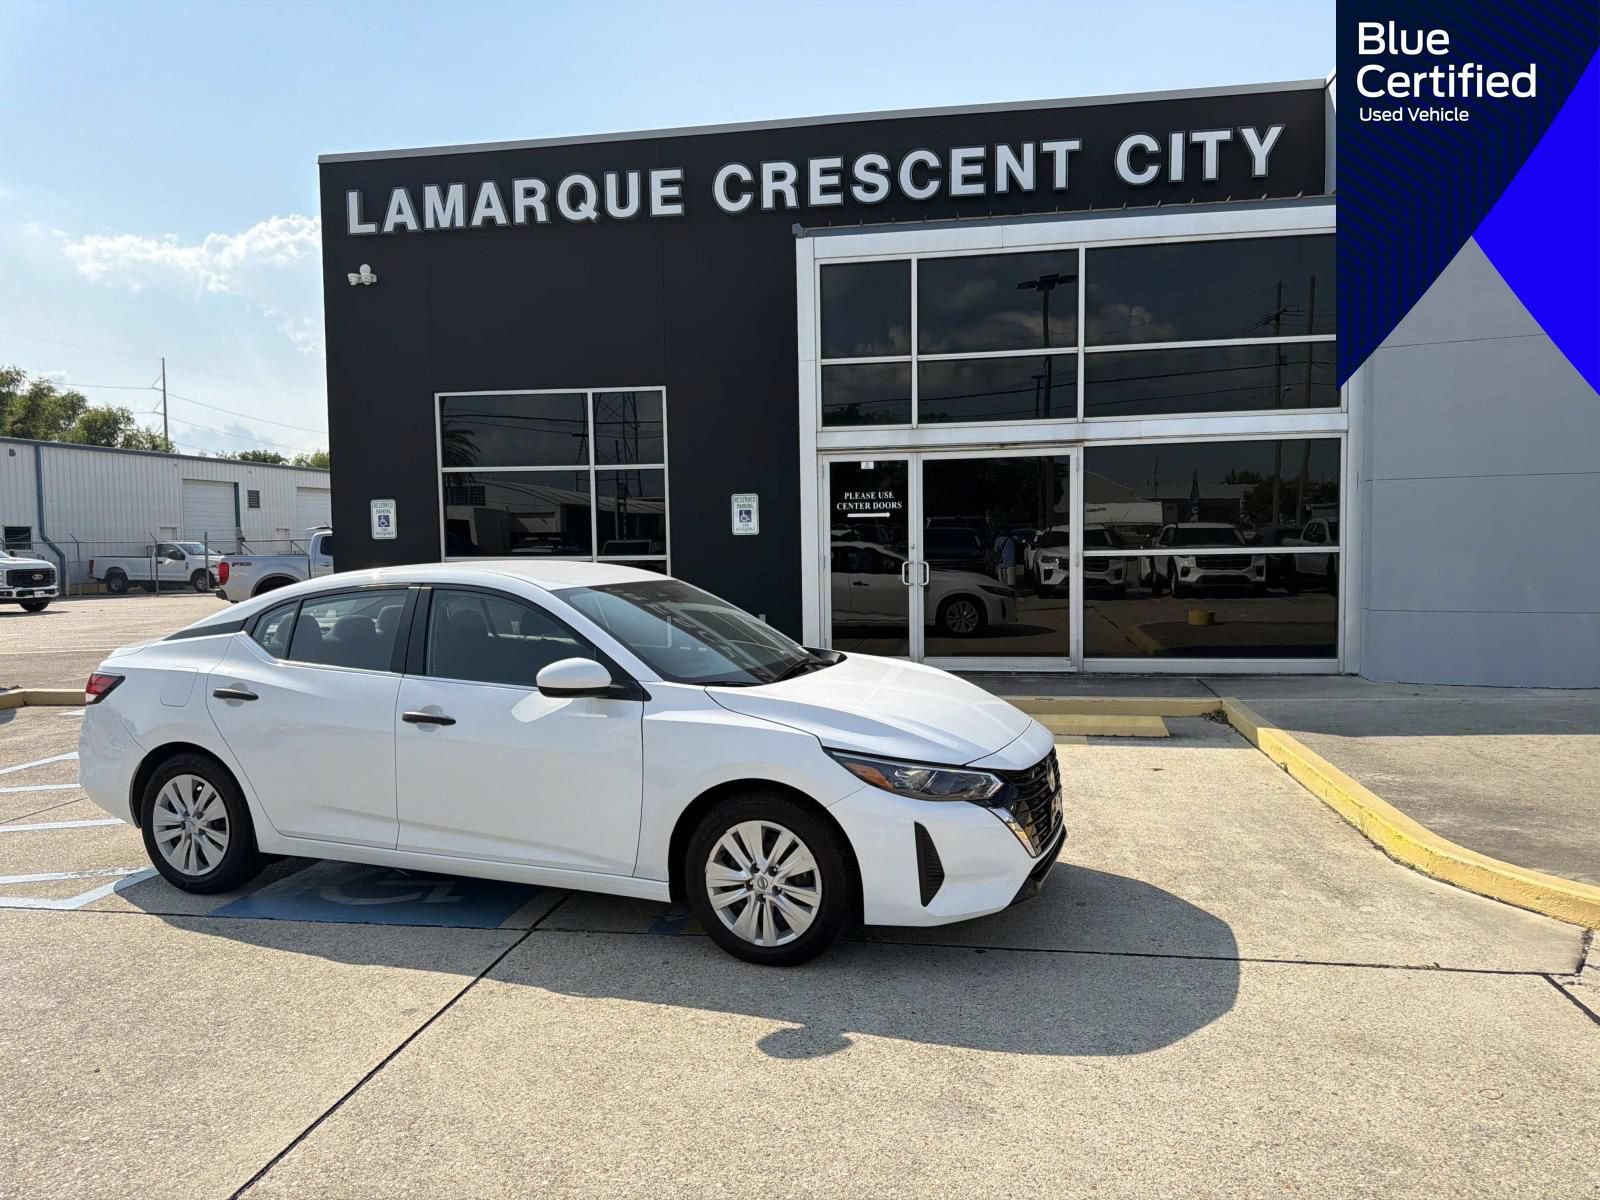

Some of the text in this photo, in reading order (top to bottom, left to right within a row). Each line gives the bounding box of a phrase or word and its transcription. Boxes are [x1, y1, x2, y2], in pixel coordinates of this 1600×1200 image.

[346, 123, 1286, 235] LAMARQUE CRESCENT CITY
[844, 490, 895, 500] PLEASE USE
[836, 501, 902, 511] CENTER DOORS
